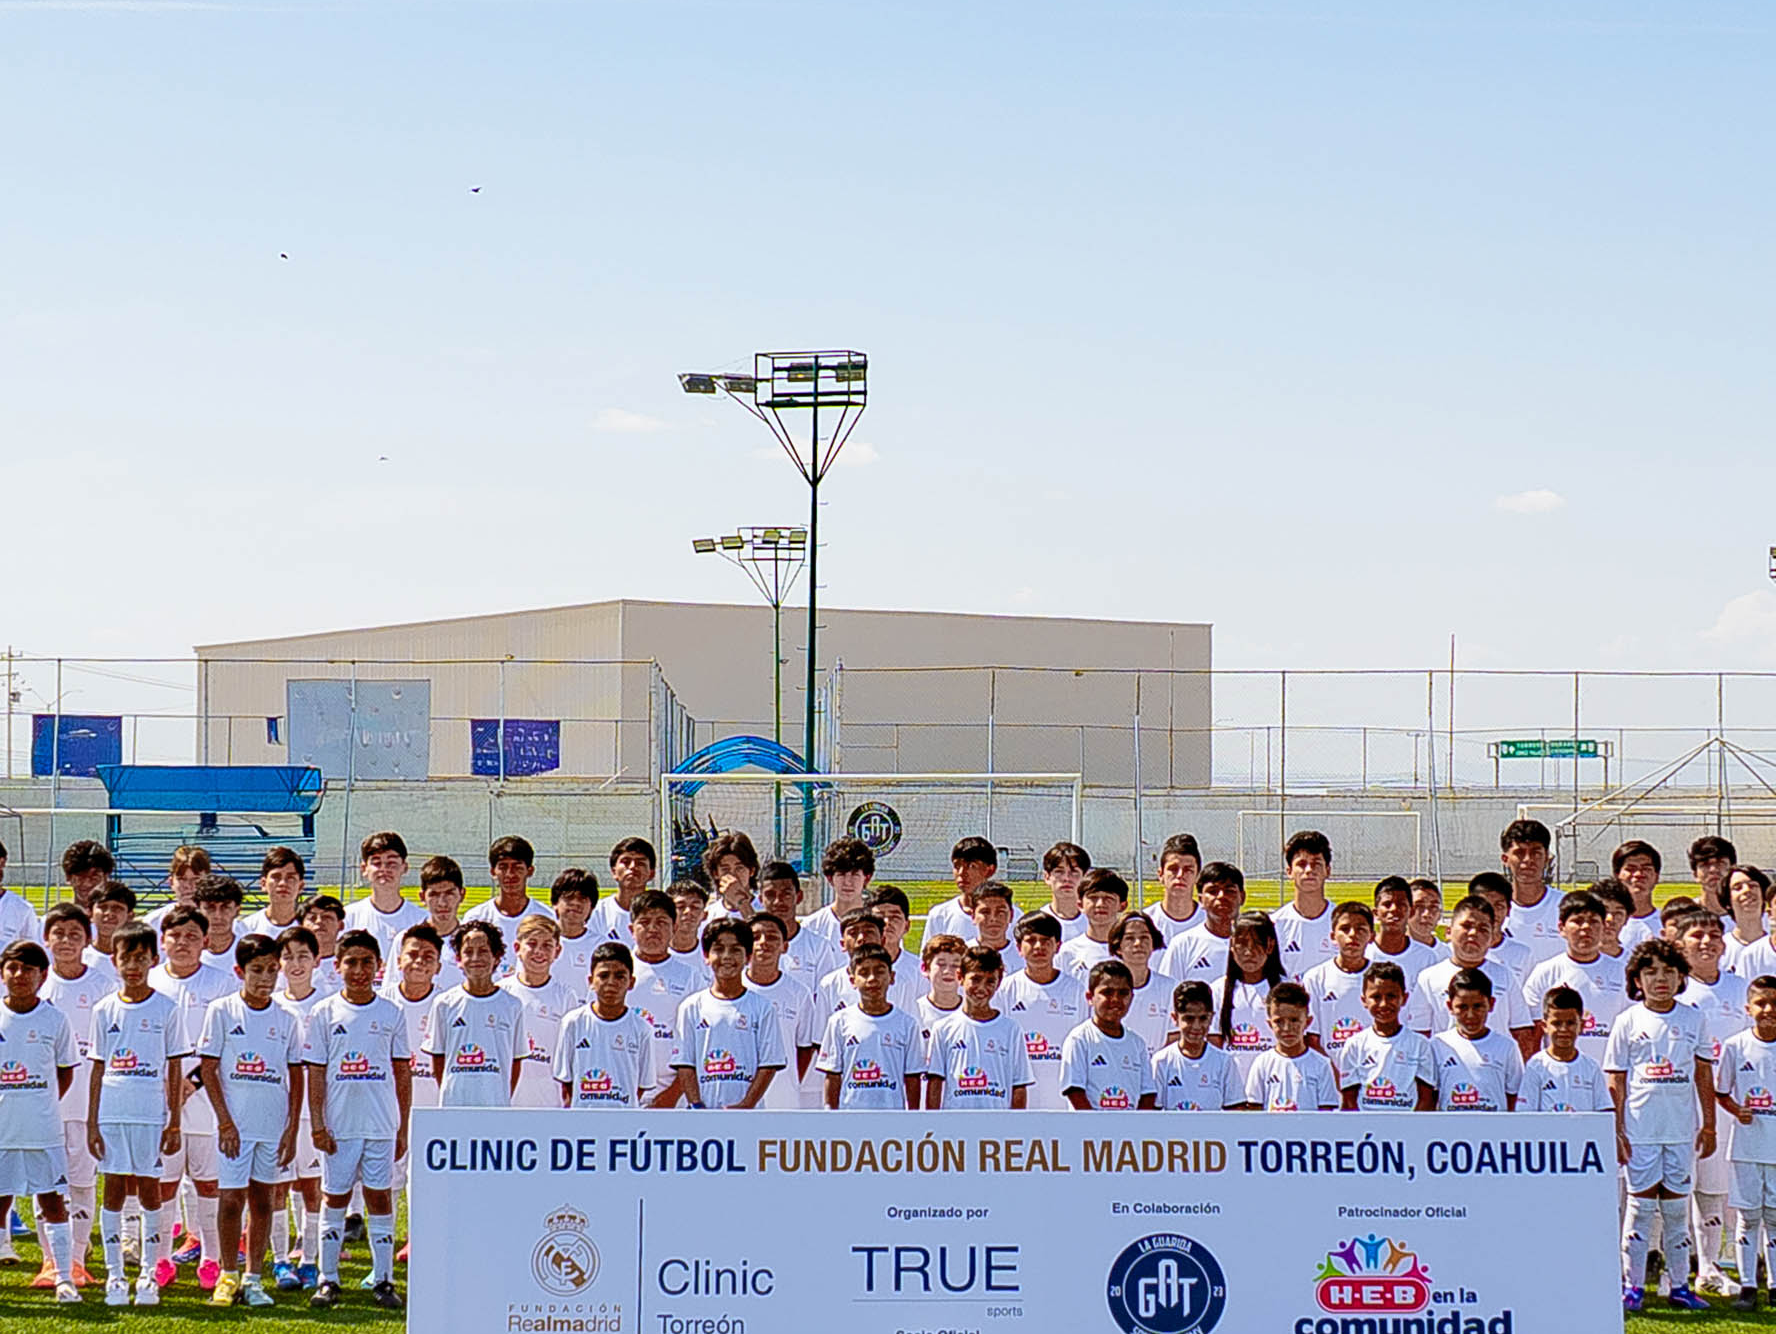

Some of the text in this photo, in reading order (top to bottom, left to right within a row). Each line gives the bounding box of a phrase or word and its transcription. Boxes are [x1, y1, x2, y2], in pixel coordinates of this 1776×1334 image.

[426, 1130, 1605, 1181] CLINIC DE FÚTBOL FUNDACIÓN REAL MADRID TORREÓN, COAHUILA
[887, 1206, 989, 1221] Organizado por
[1111, 1202, 1221, 1216] En Colaboración
[1338, 1206, 1467, 1219] Patrocinador Oficial
[658, 1258, 774, 1296] Clinic
[851, 1245, 1021, 1293] TRUE
[1110, 1286, 1122, 1297] 20
[1432, 1290, 1455, 1304] en
[1459, 1287, 1478, 1304] la
[986, 1306, 1024, 1318] sports
[507, 1314, 622, 1333] Realmadrid
